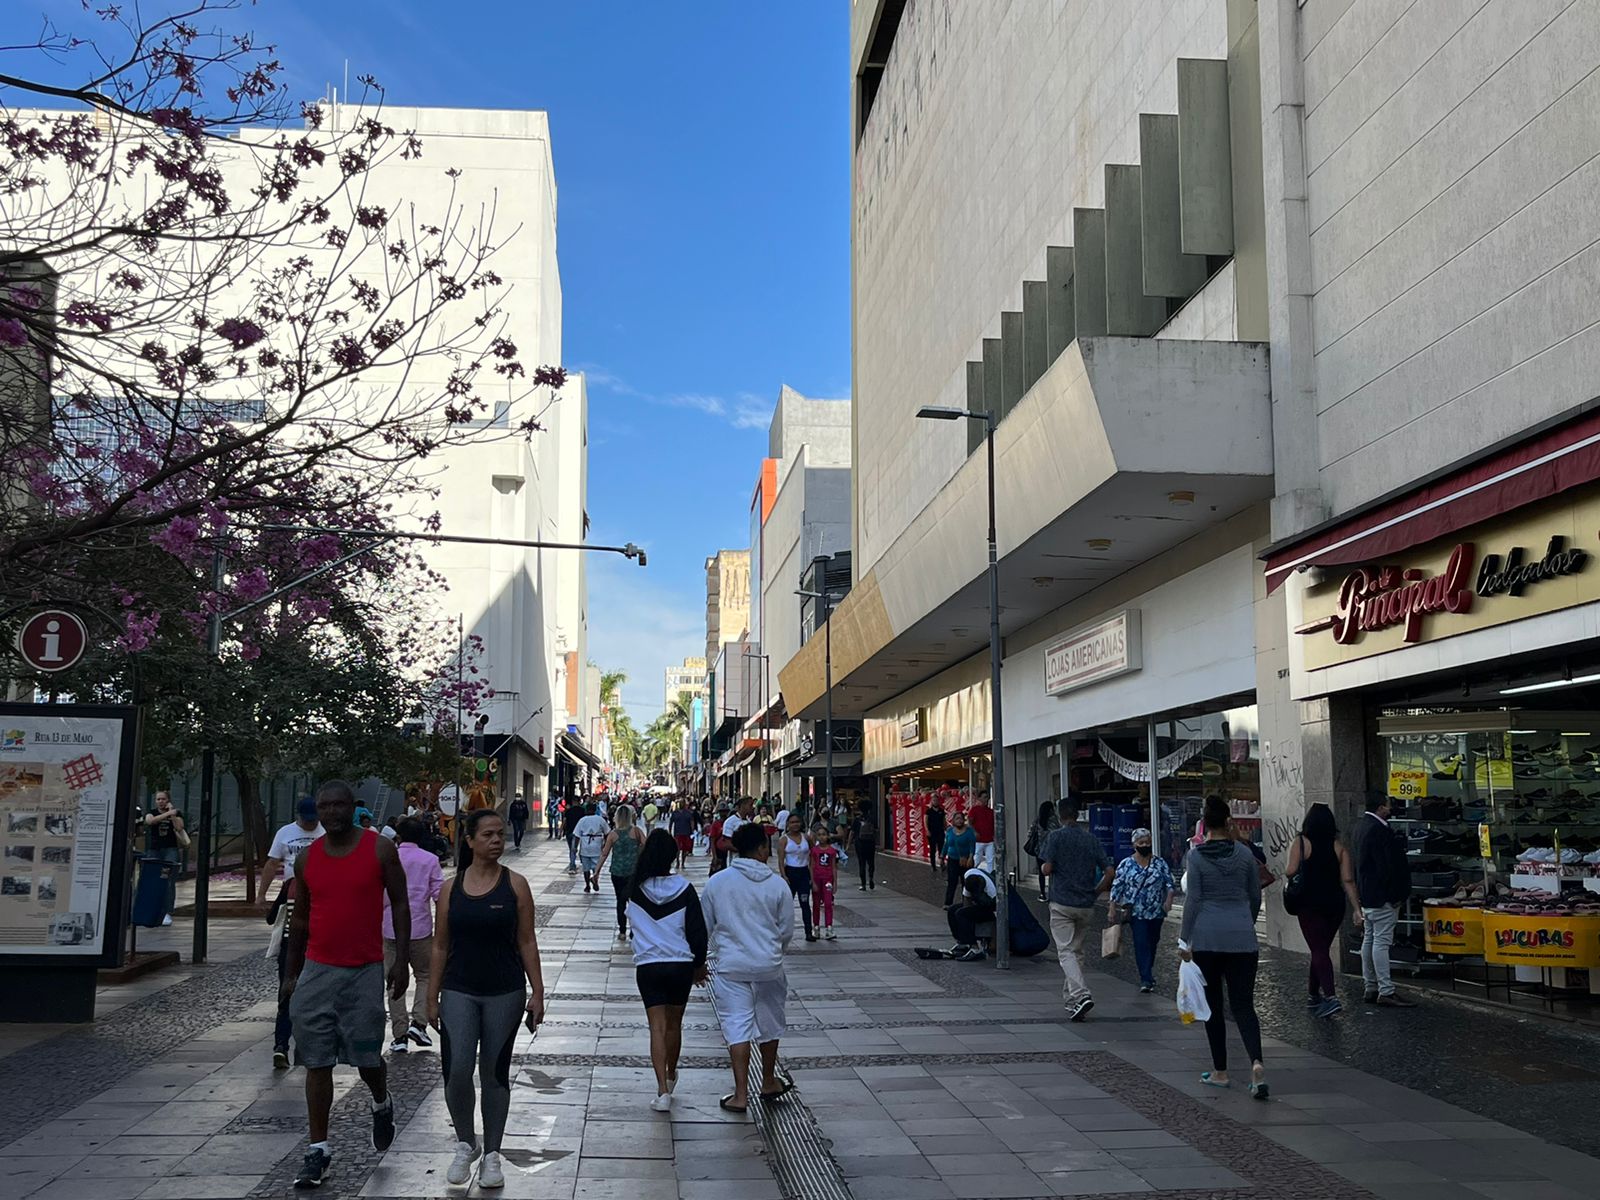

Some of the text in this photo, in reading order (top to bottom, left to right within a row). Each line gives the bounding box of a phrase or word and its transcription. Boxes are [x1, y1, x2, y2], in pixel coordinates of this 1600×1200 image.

[1333, 542, 1474, 644] Principal
[1047, 630, 1124, 679] LOJAS AMERICANAS
[34, 732, 50, 742] RUA
[61, 734, 72, 743] DE
[73, 733, 94, 743] MAIO
[1399, 783, 1413, 795] 99
[1494, 928, 1575, 948] LOUCURAS
